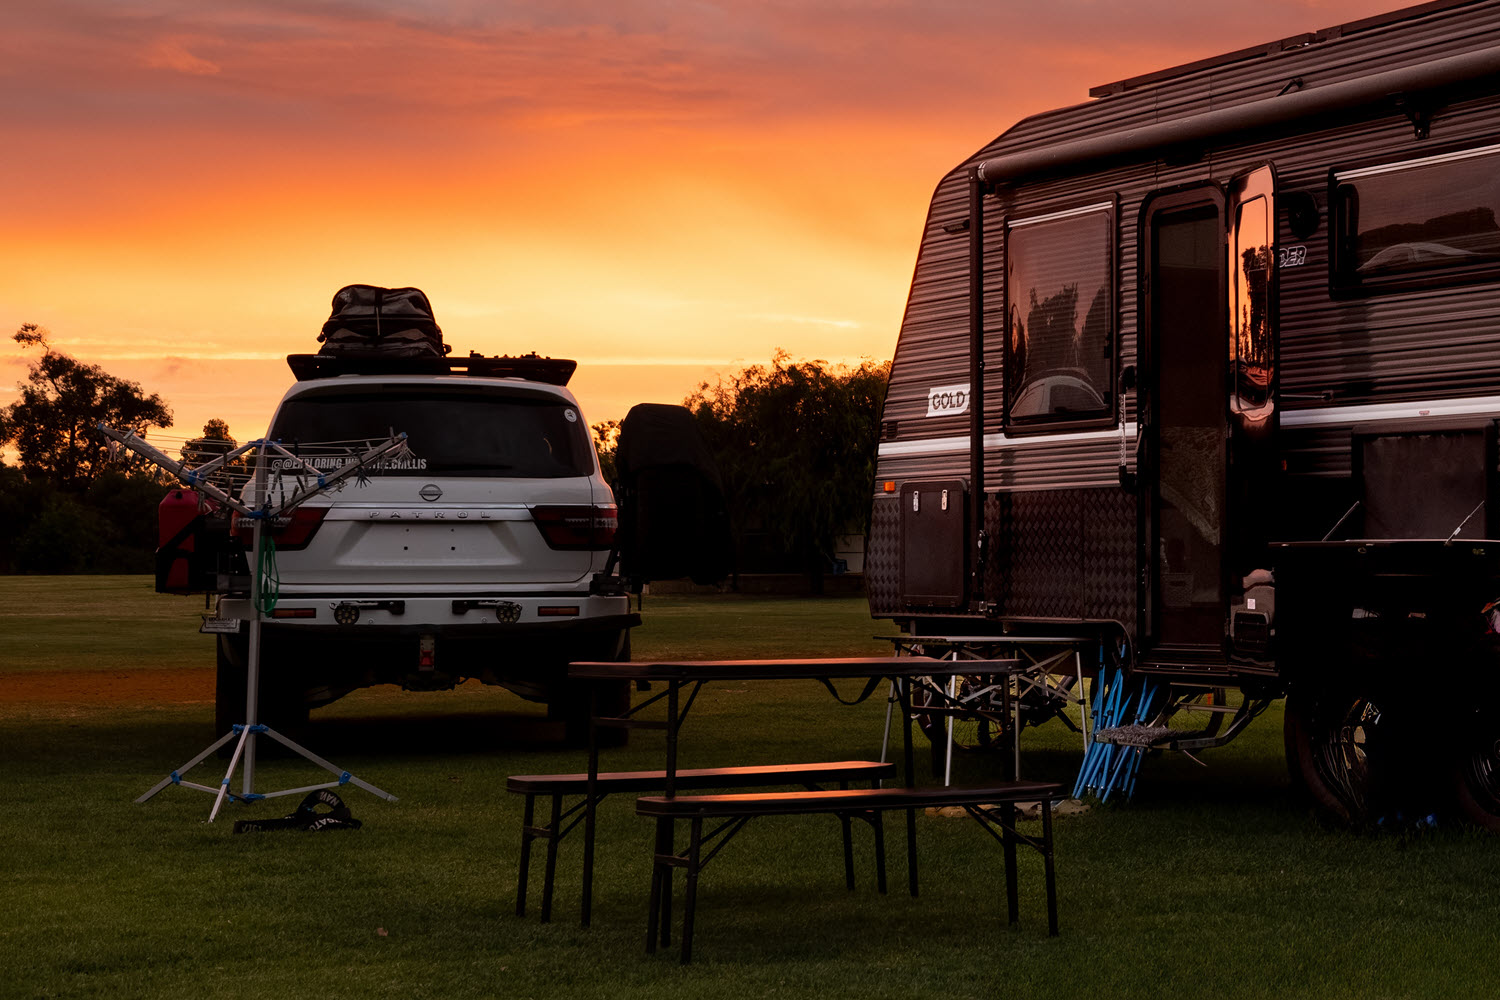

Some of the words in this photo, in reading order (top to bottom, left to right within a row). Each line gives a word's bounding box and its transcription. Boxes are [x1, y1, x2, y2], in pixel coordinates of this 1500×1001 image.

[1279, 245, 1307, 268] DER
[932, 391, 966, 410] GOLD
[369, 511, 491, 519] PATROL
